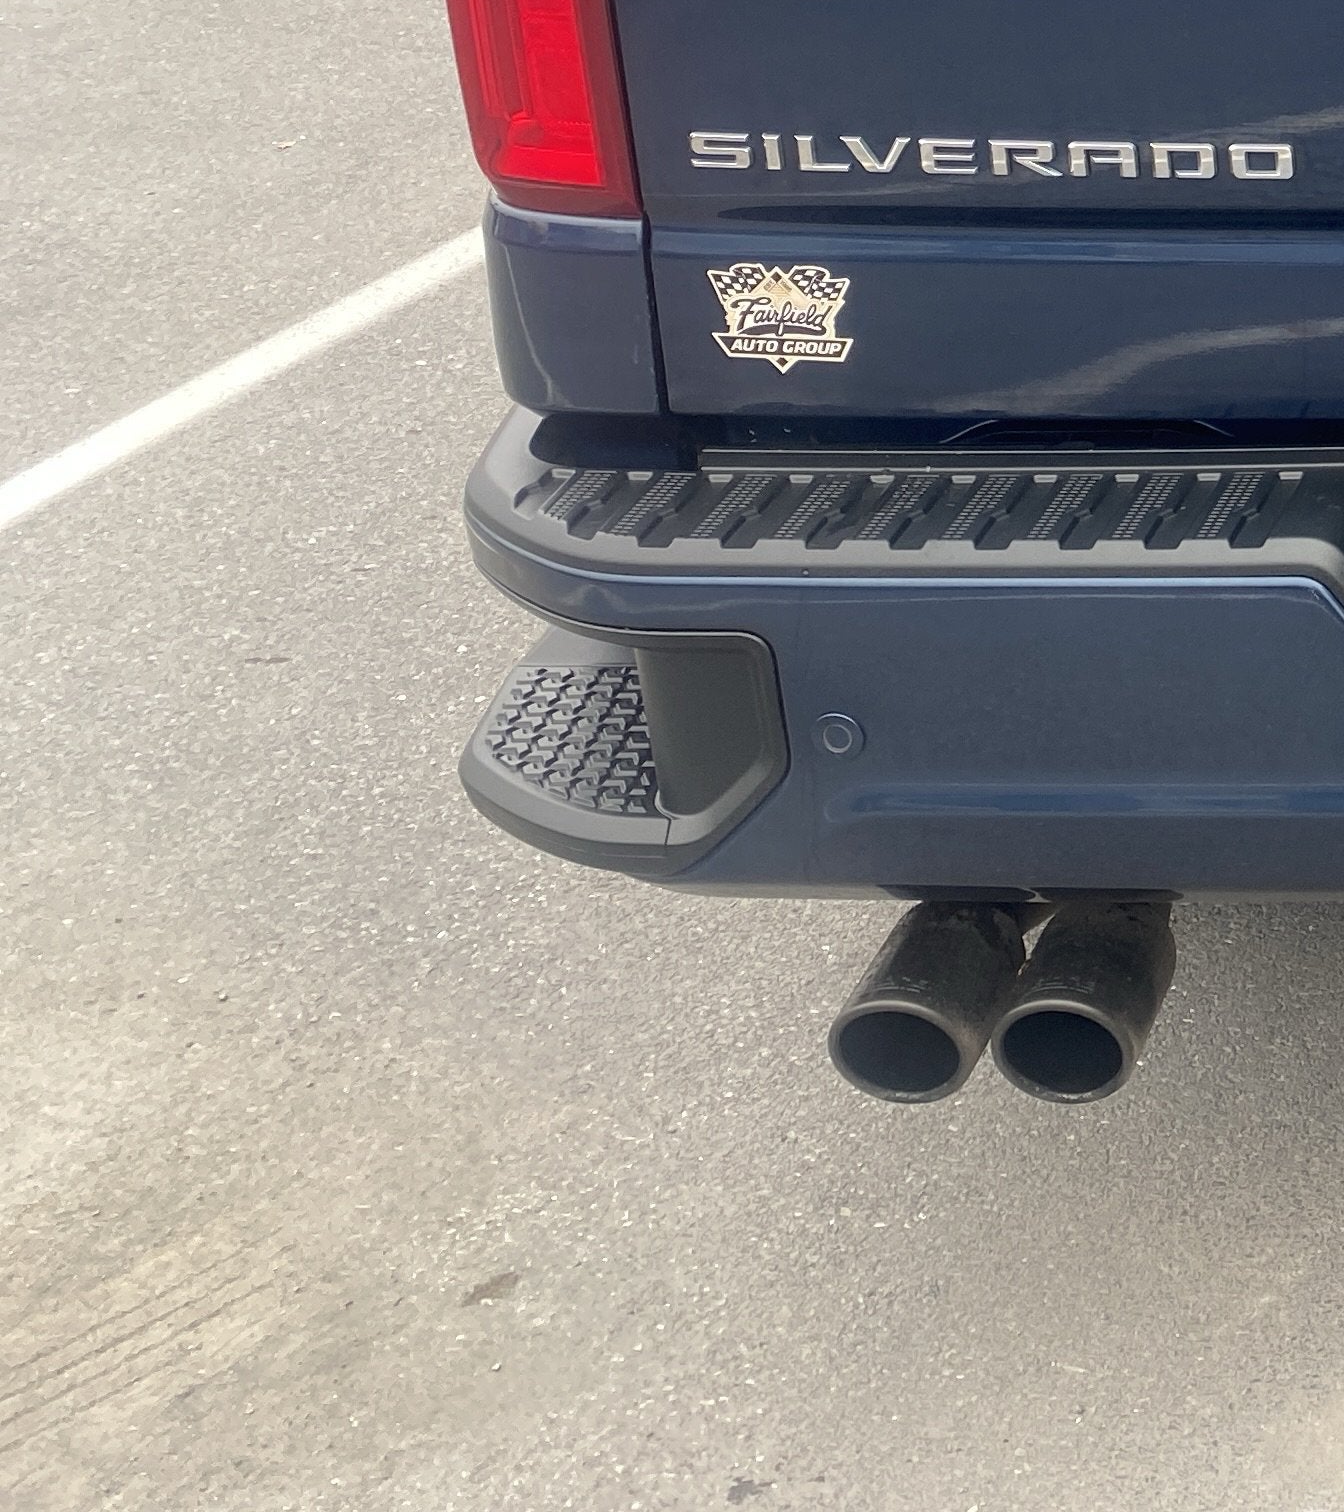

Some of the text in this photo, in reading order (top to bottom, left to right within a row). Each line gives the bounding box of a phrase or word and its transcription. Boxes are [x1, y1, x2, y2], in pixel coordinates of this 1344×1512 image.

[688, 130, 1296, 180] SILVERADO
[730, 296, 832, 337] Fairfield
[730, 338, 842, 355] AUTO GROUP
